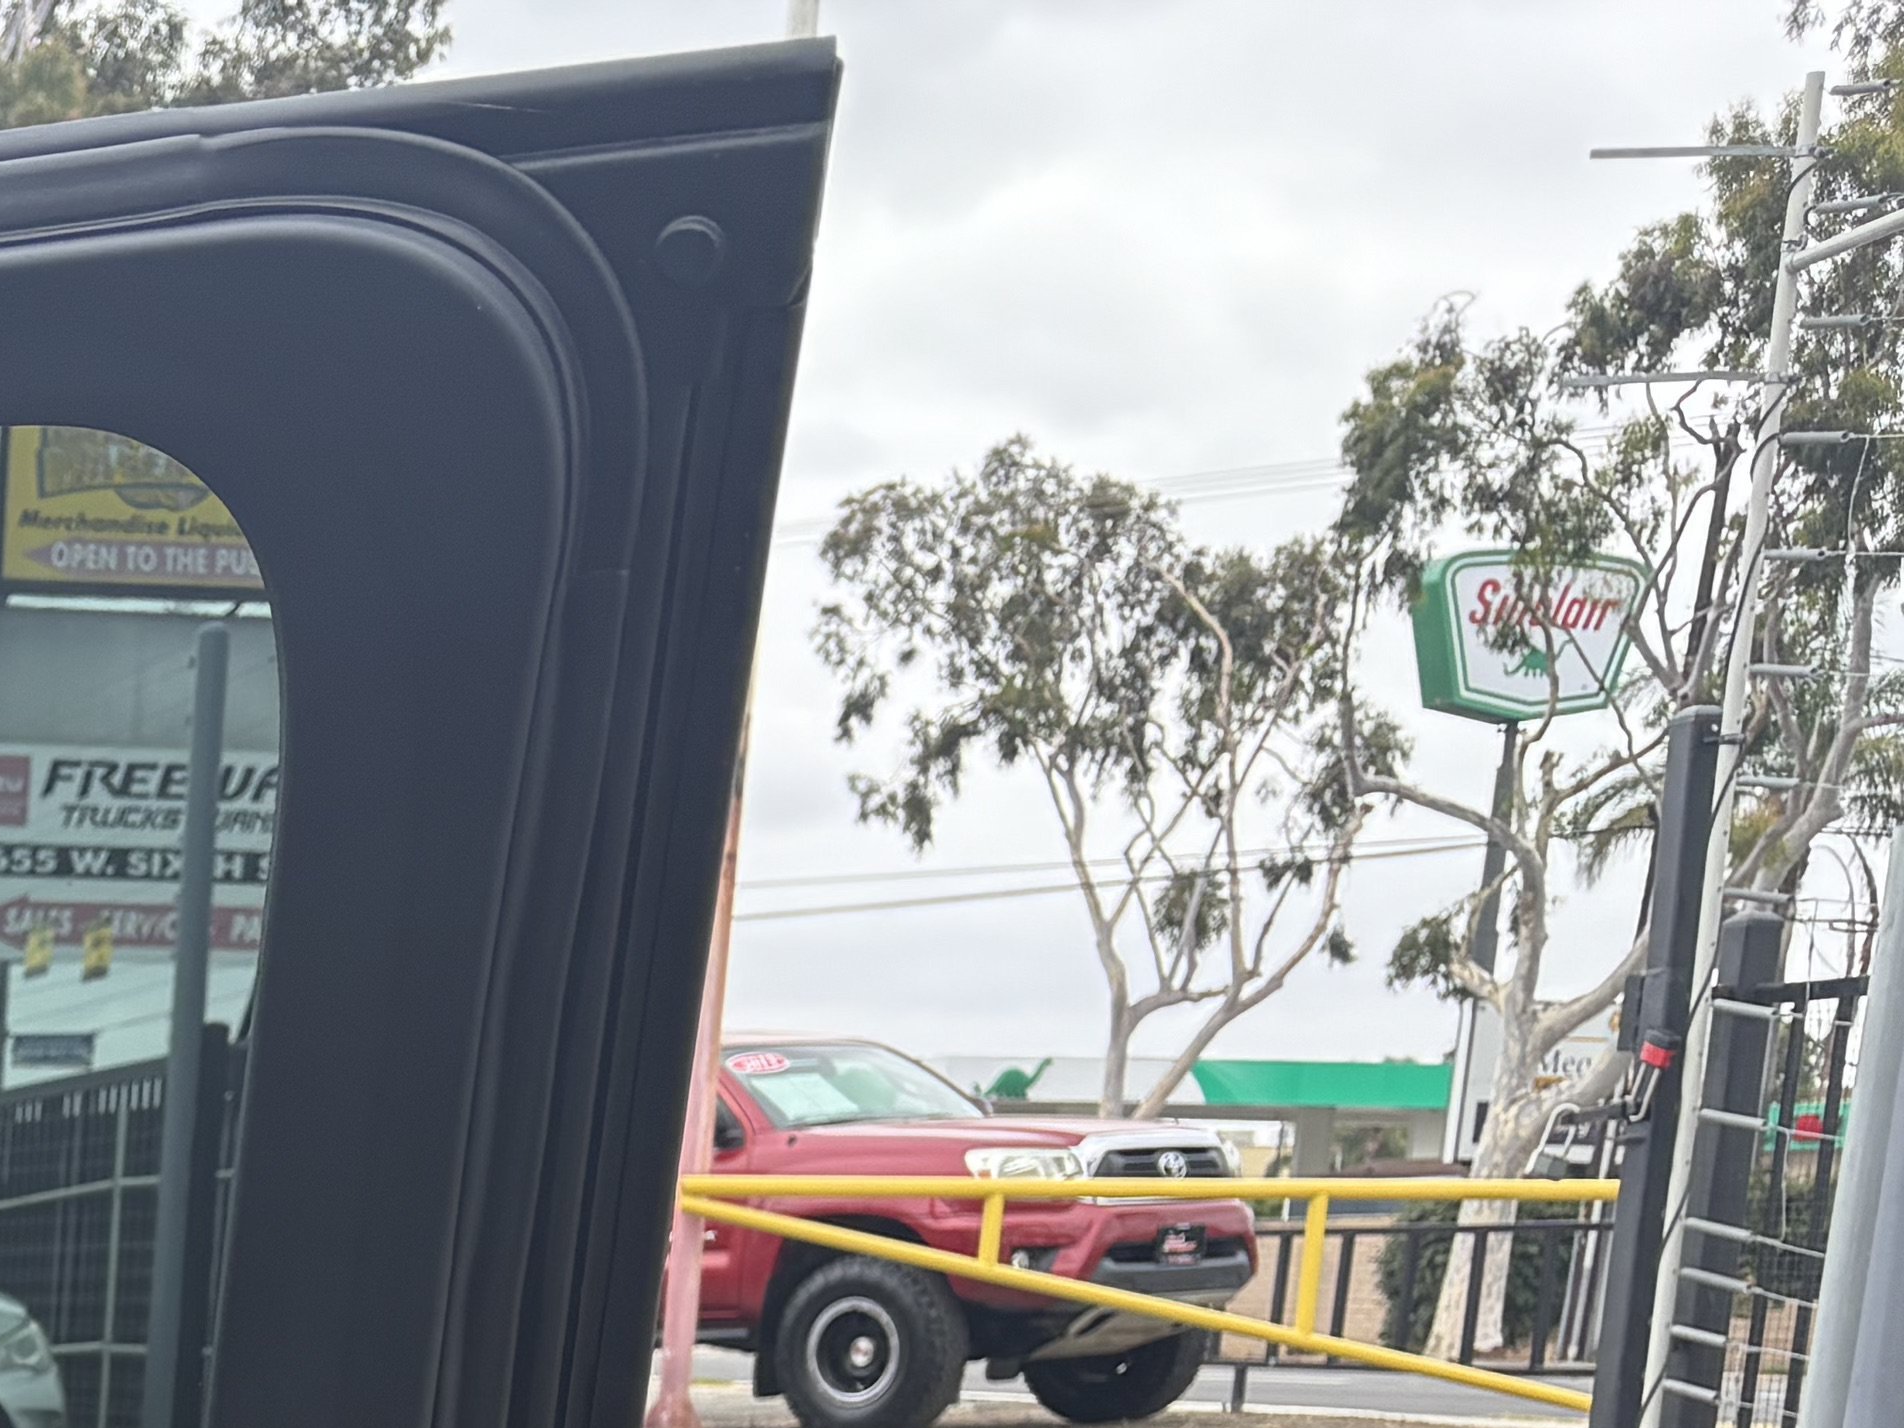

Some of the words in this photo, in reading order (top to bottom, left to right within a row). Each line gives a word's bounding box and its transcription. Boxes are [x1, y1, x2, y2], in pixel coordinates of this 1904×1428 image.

[50, 540, 118, 570] OPEN
[124, 545, 158, 572] TO
[164, 546, 210, 574] THE
[62, 804, 181, 830] TRUCKS
[69, 849, 116, 876] W.
[127, 852, 243, 879] SIXH
